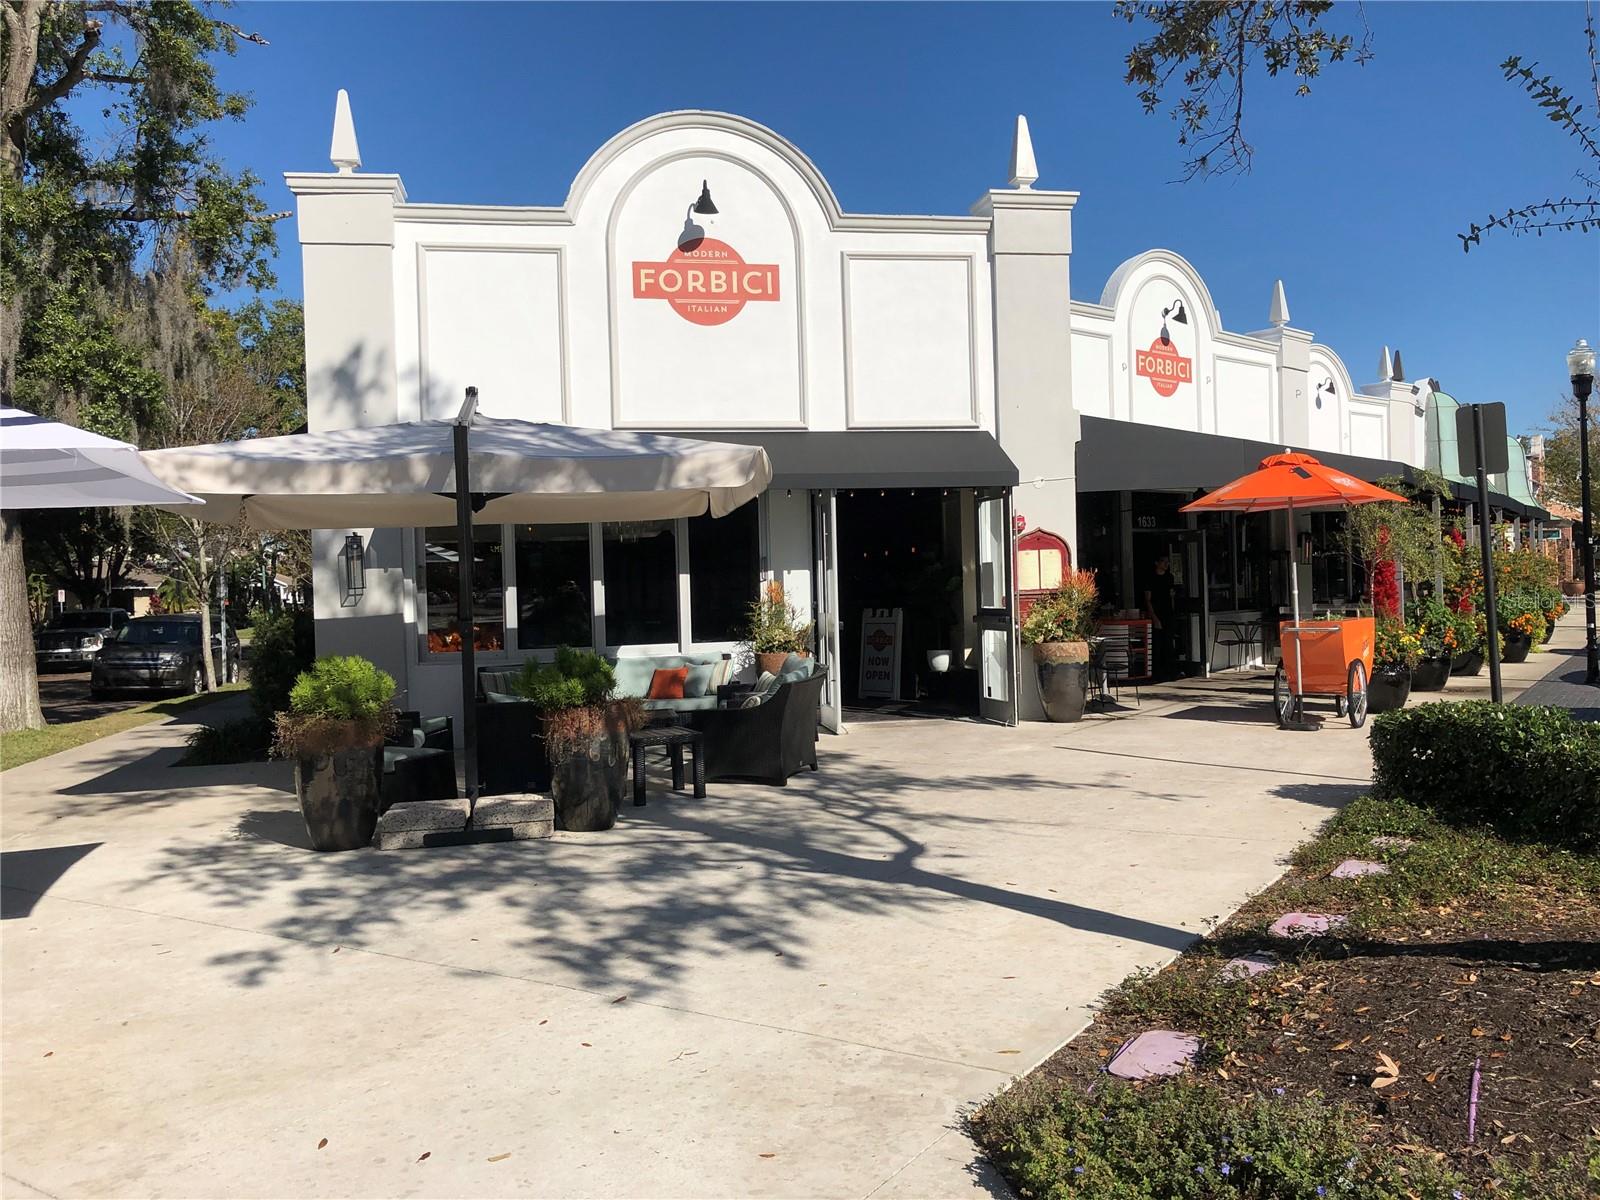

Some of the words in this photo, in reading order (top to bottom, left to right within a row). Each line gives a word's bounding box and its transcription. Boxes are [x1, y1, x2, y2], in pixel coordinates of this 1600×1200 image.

[684, 250, 728, 258] MODERN
[639, 268, 773, 294] FORBICI
[687, 305, 728, 313] ITALIAN
[1138, 354, 1190, 379] FORBICI
[1138, 516, 1156, 527] 1633
[868, 656, 890, 666] NOW
[865, 670, 891, 680] OPEN
